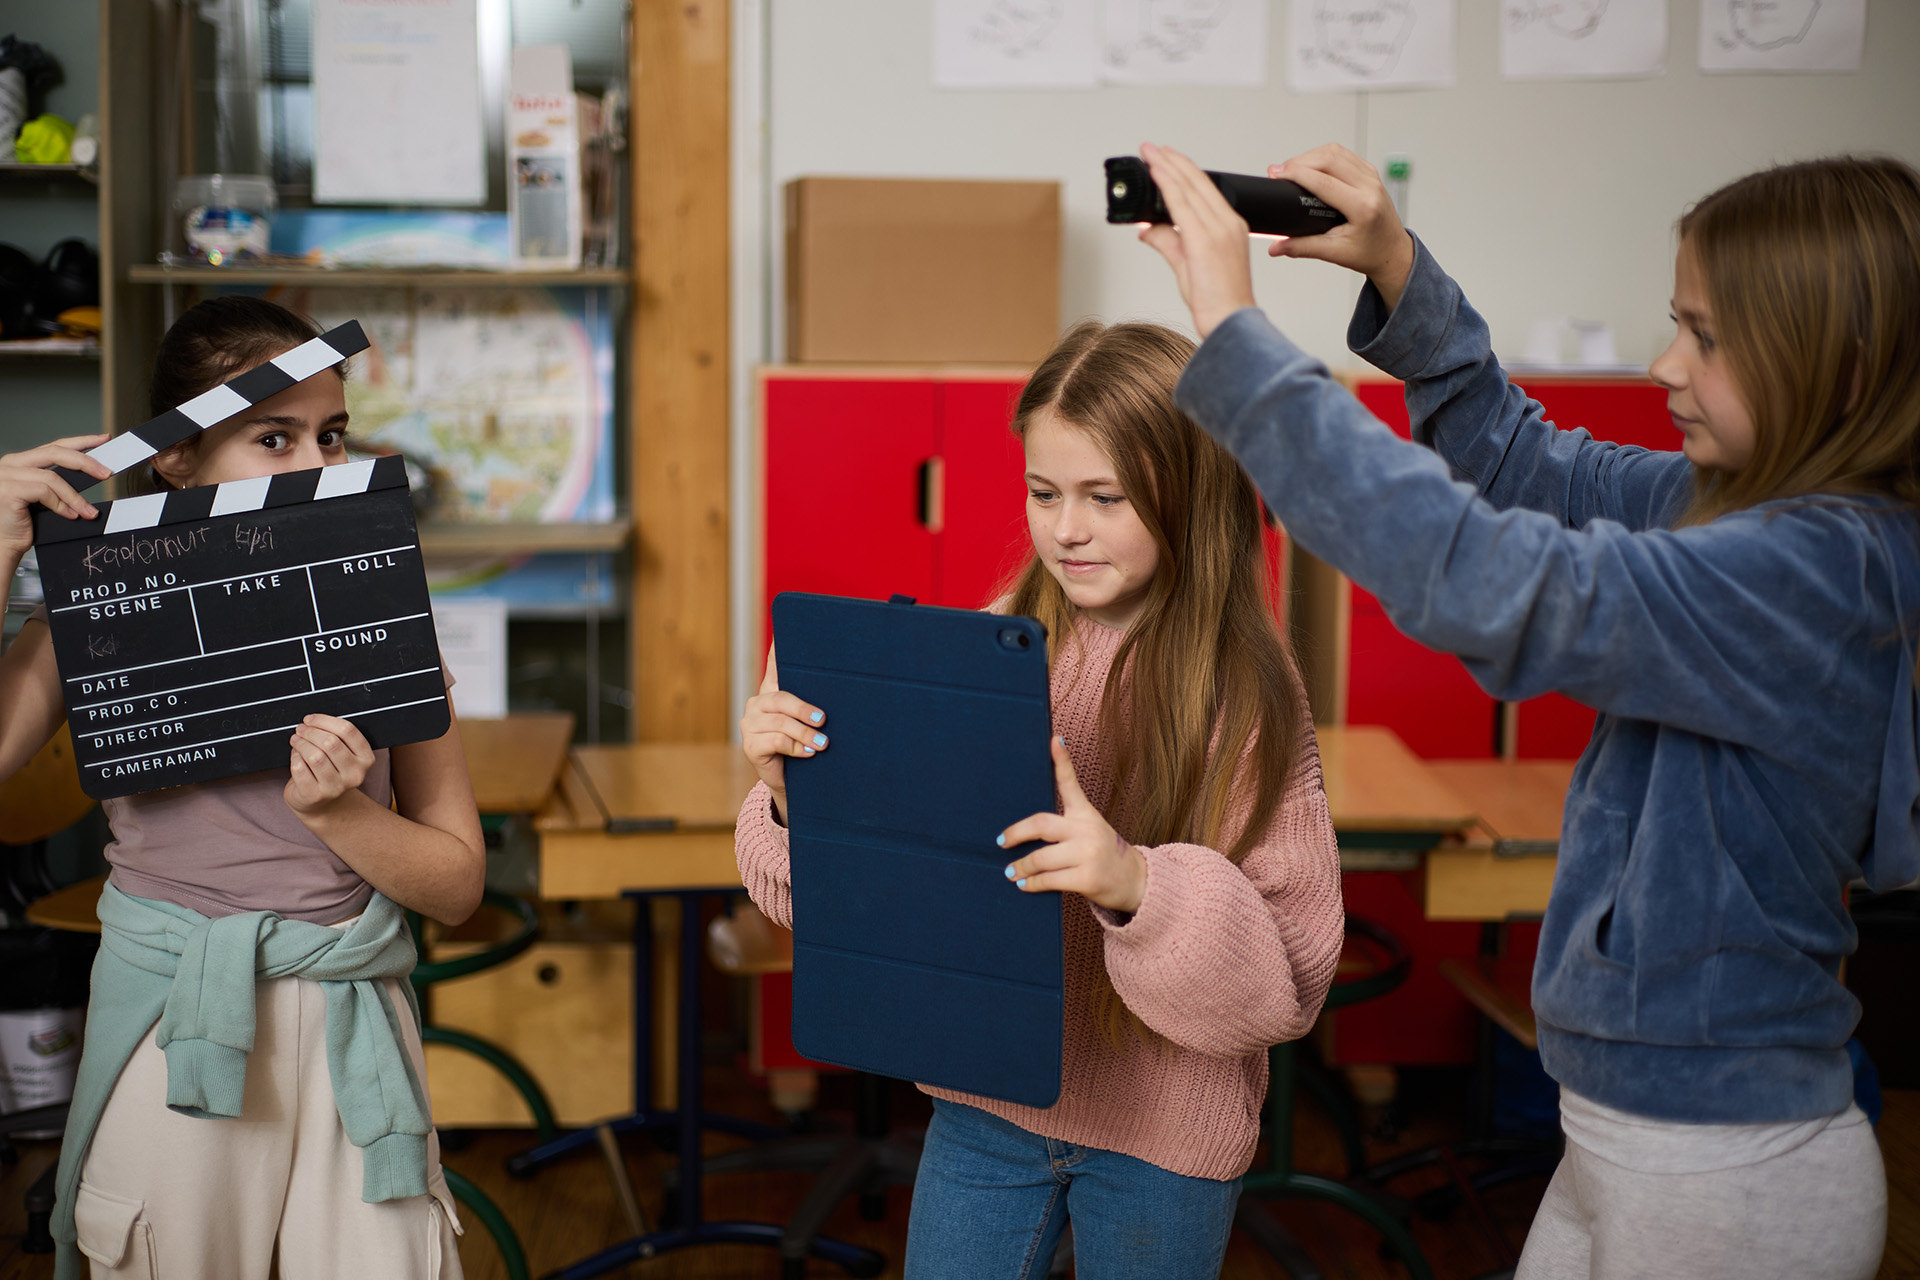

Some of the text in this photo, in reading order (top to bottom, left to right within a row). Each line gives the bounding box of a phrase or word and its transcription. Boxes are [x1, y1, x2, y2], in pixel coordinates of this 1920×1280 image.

[342, 554, 396, 574] ROLL
[223, 574, 281, 596] TAKE
[89, 596, 162, 620] SCENE
[314, 628, 388, 652] SOUND
[81, 675, 130, 694] DATE
[94, 721, 185, 748] DIRECTOR
[101, 747, 217, 779] CAMERAMAN
